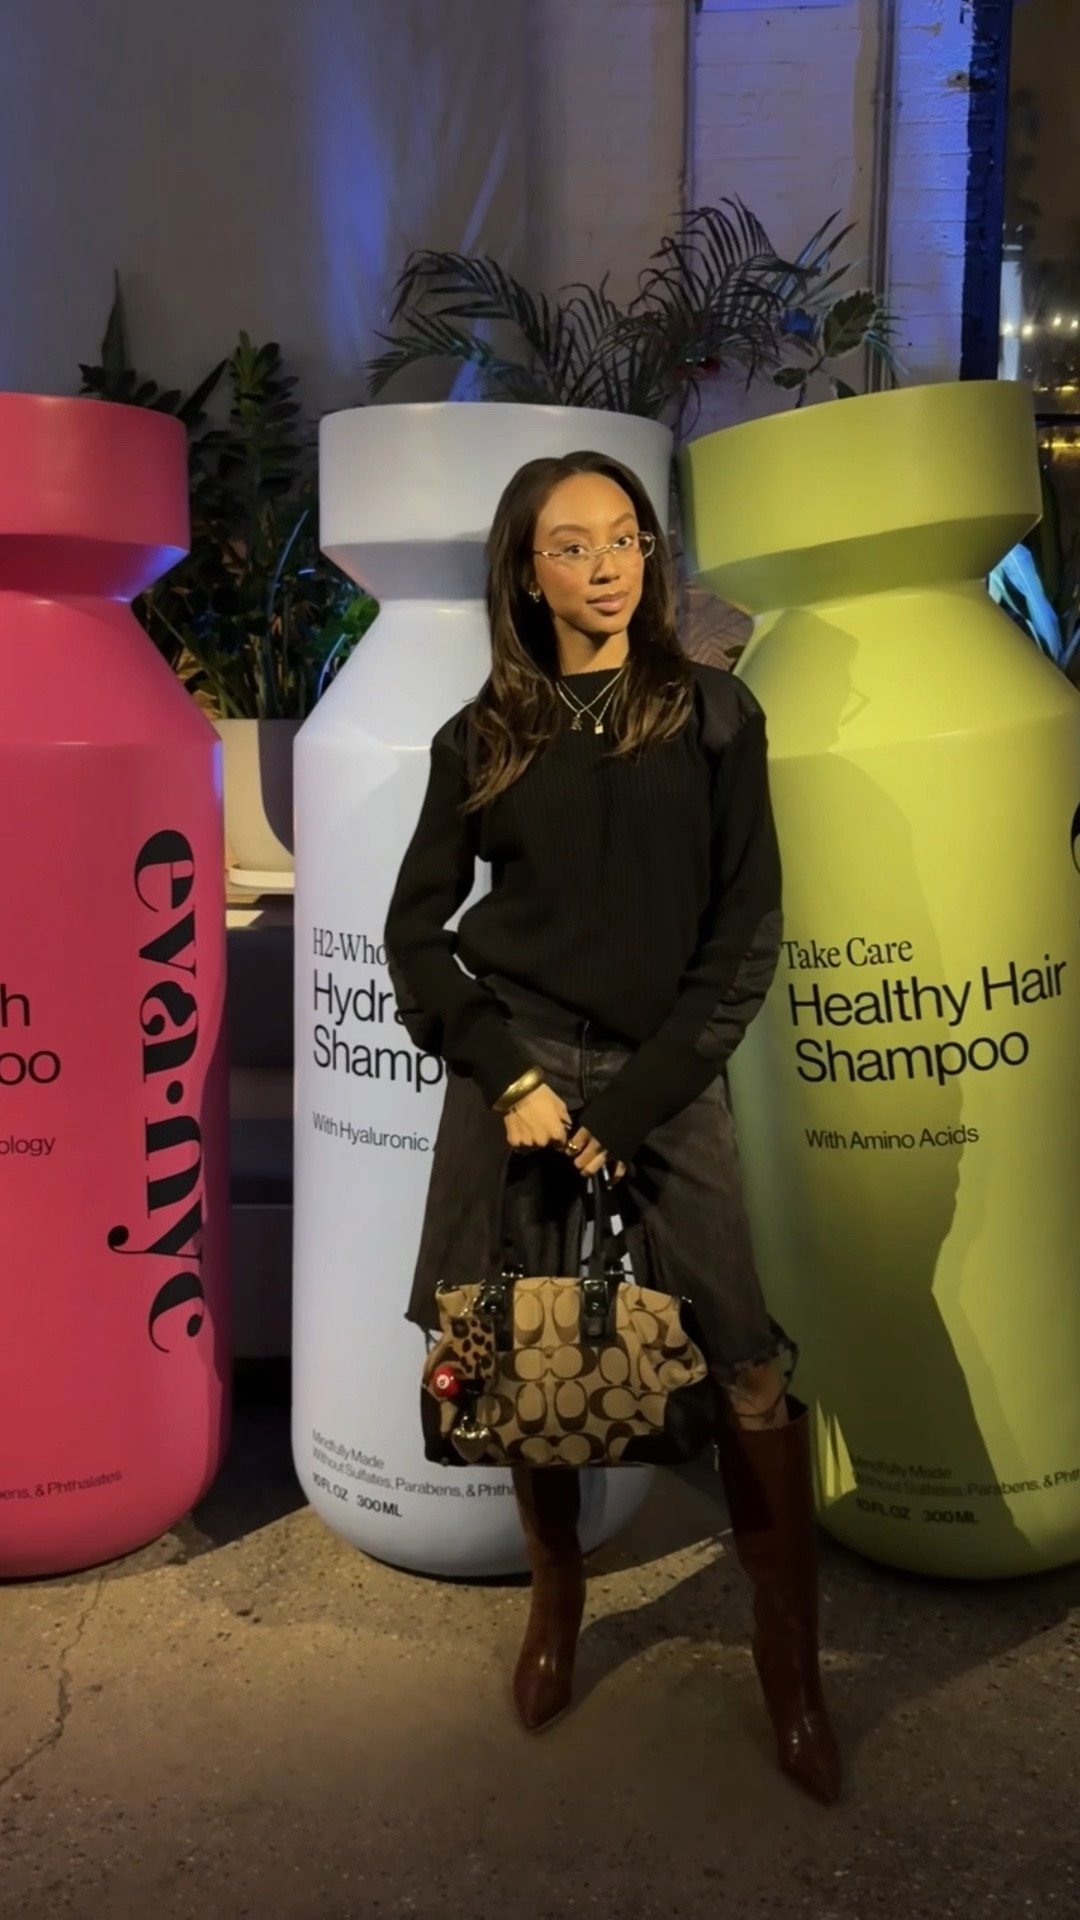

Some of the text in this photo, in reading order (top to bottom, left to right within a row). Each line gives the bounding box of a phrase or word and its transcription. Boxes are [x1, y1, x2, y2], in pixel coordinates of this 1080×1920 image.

[781, 937, 913, 969] Take Care
[788, 953, 1067, 1027] Healthy Hair
[795, 1031, 1029, 1086] Shampoo
[312, 1111, 429, 1152] With Hyaluronic
[805, 1125, 980, 1150] With Amino Acids
[466, 1484, 475, 1498] &
[1043, 1474, 1053, 1488] &
